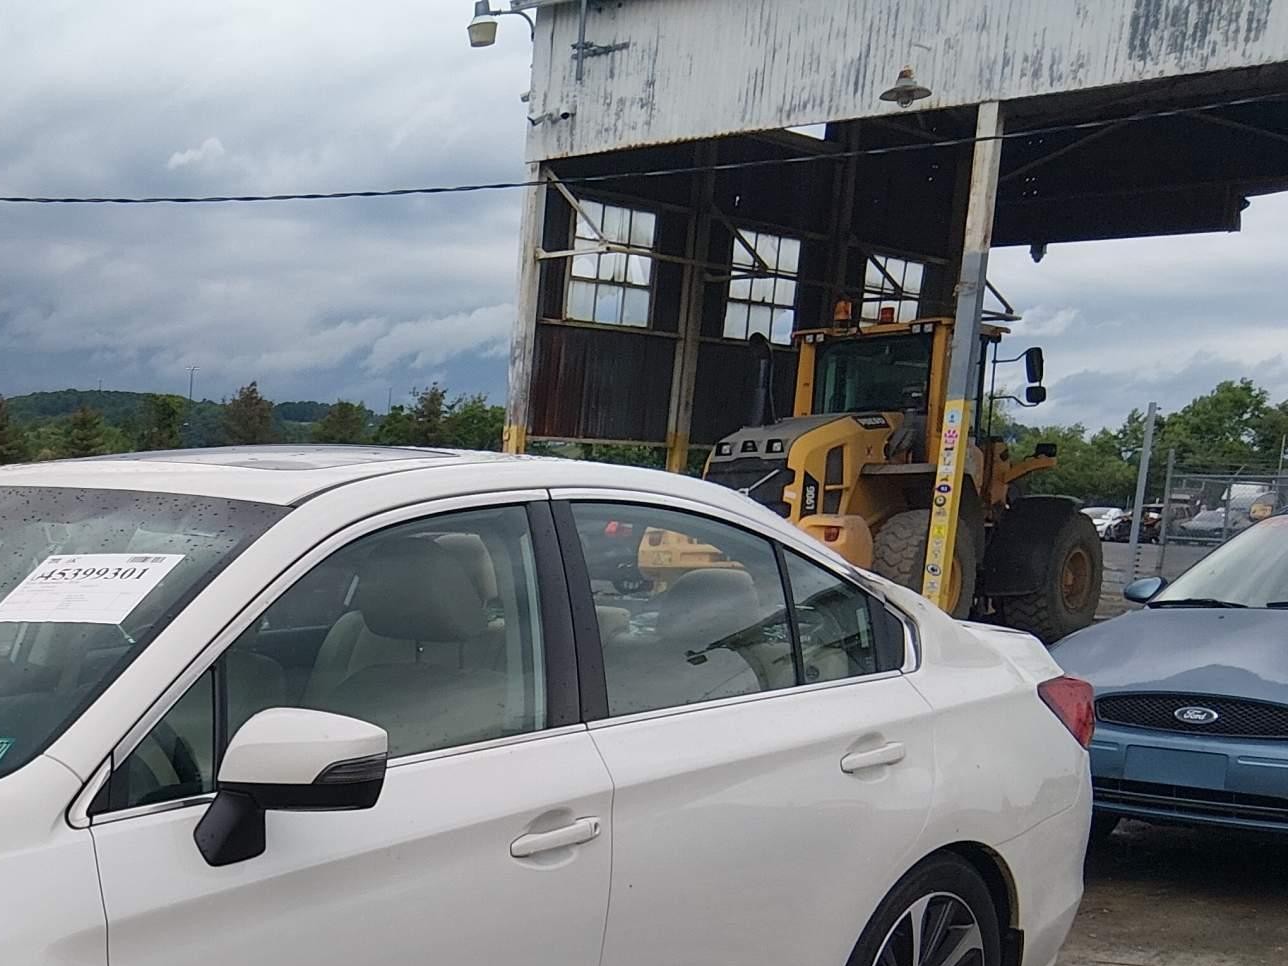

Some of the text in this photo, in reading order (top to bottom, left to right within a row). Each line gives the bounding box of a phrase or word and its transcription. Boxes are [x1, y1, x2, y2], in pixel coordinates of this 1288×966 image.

[805, 485, 816, 510] L90G
[34, 567, 150, 580] 45399301
[1183, 710, 1207, 720] Ford
